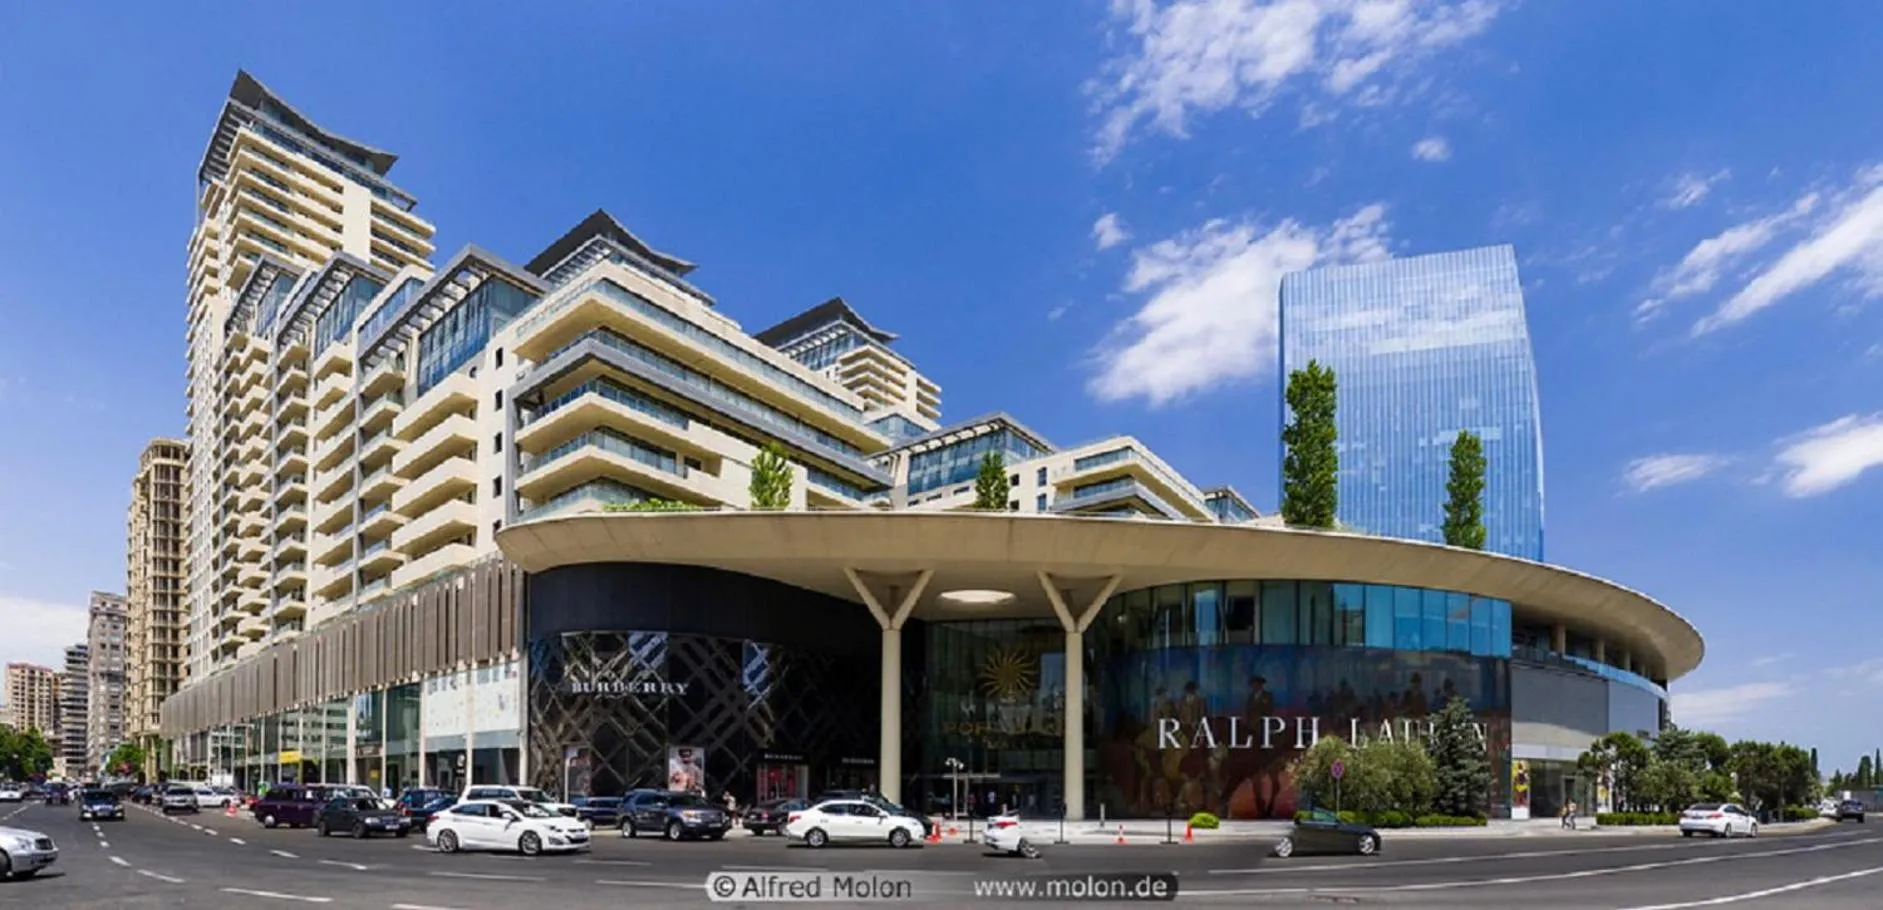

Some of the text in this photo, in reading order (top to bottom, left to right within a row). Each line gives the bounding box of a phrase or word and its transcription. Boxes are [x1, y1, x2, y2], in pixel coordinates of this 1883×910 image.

[571, 682, 688, 695] BURBERRY
[1158, 716, 1487, 751] RALPH LAUN
